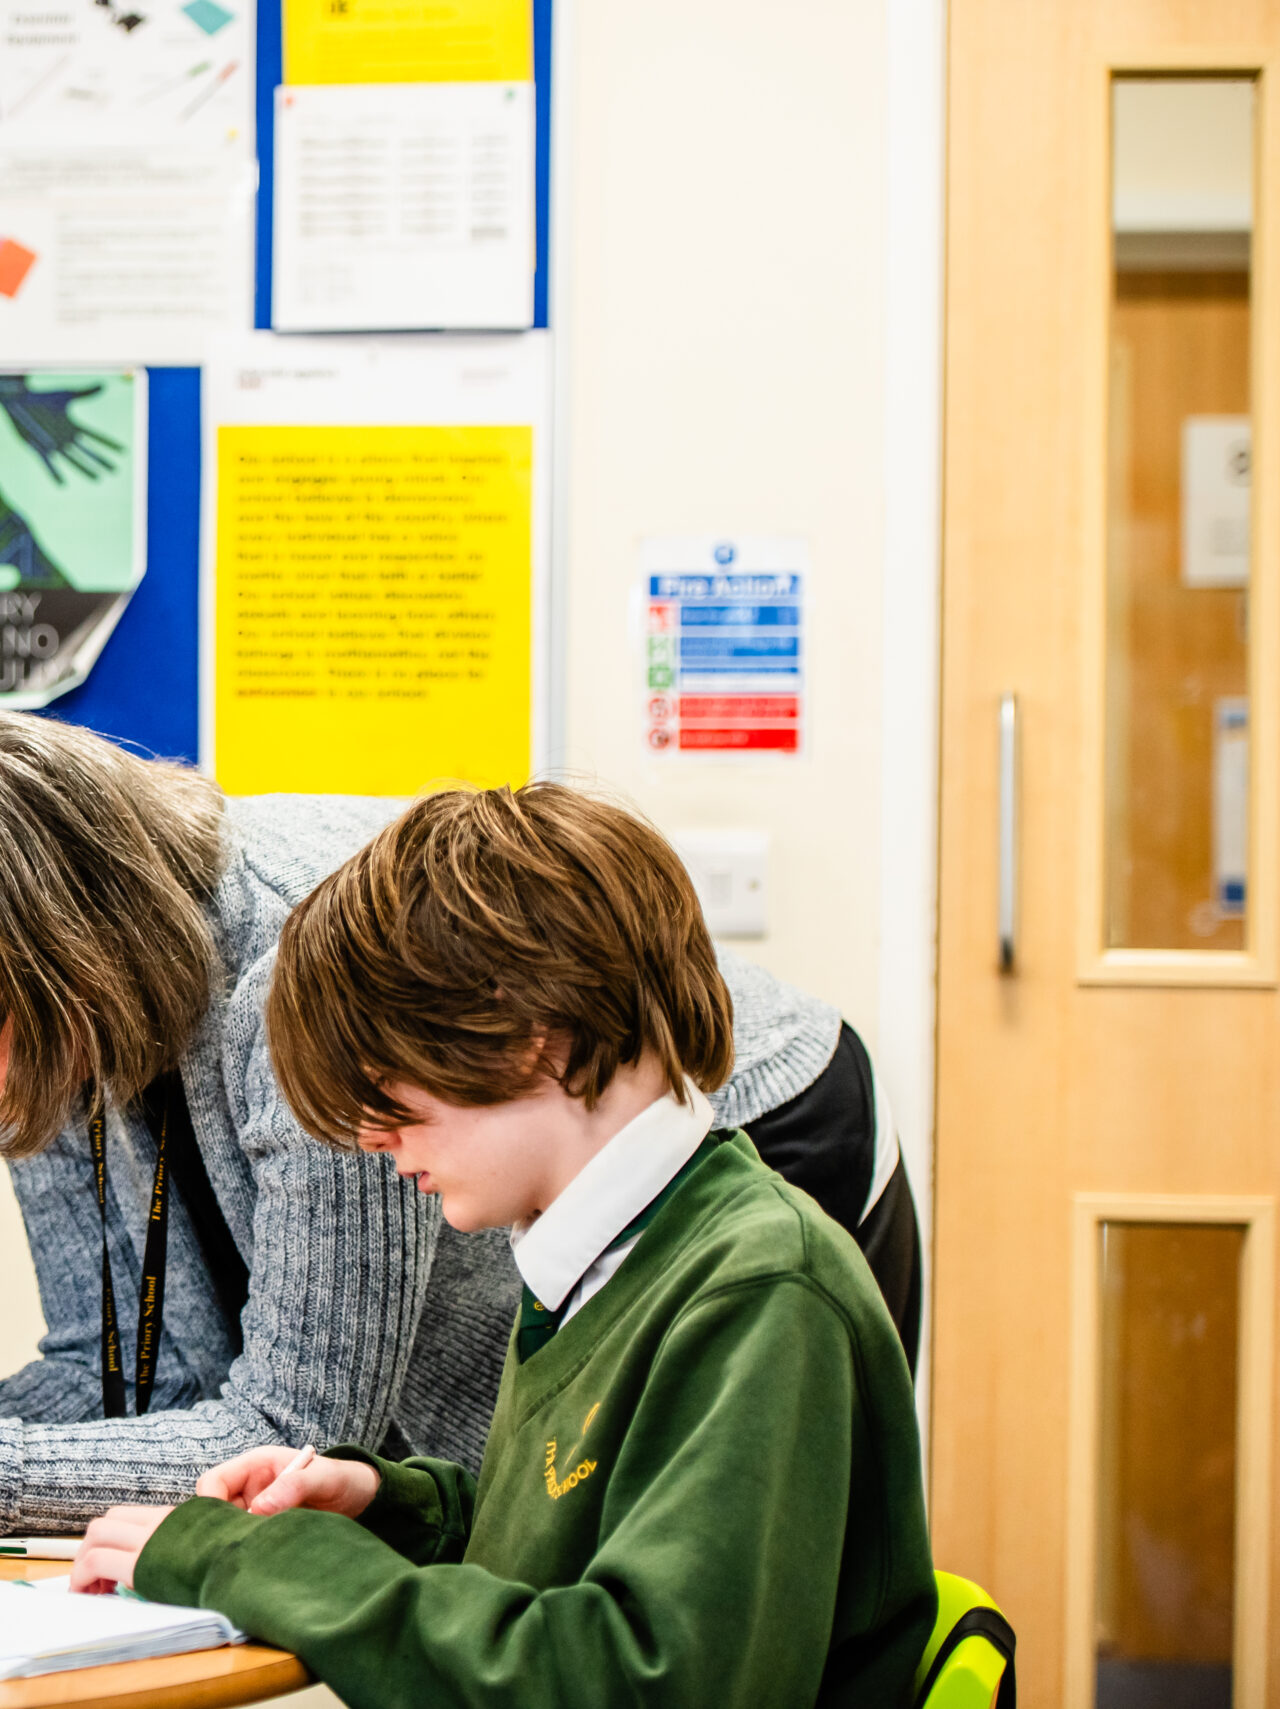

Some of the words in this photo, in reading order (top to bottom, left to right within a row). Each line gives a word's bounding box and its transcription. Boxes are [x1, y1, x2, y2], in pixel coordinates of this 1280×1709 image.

[144, 1275, 157, 1317] School
[108, 1330, 119, 1372] School
[141, 1322, 155, 1359] Priory
